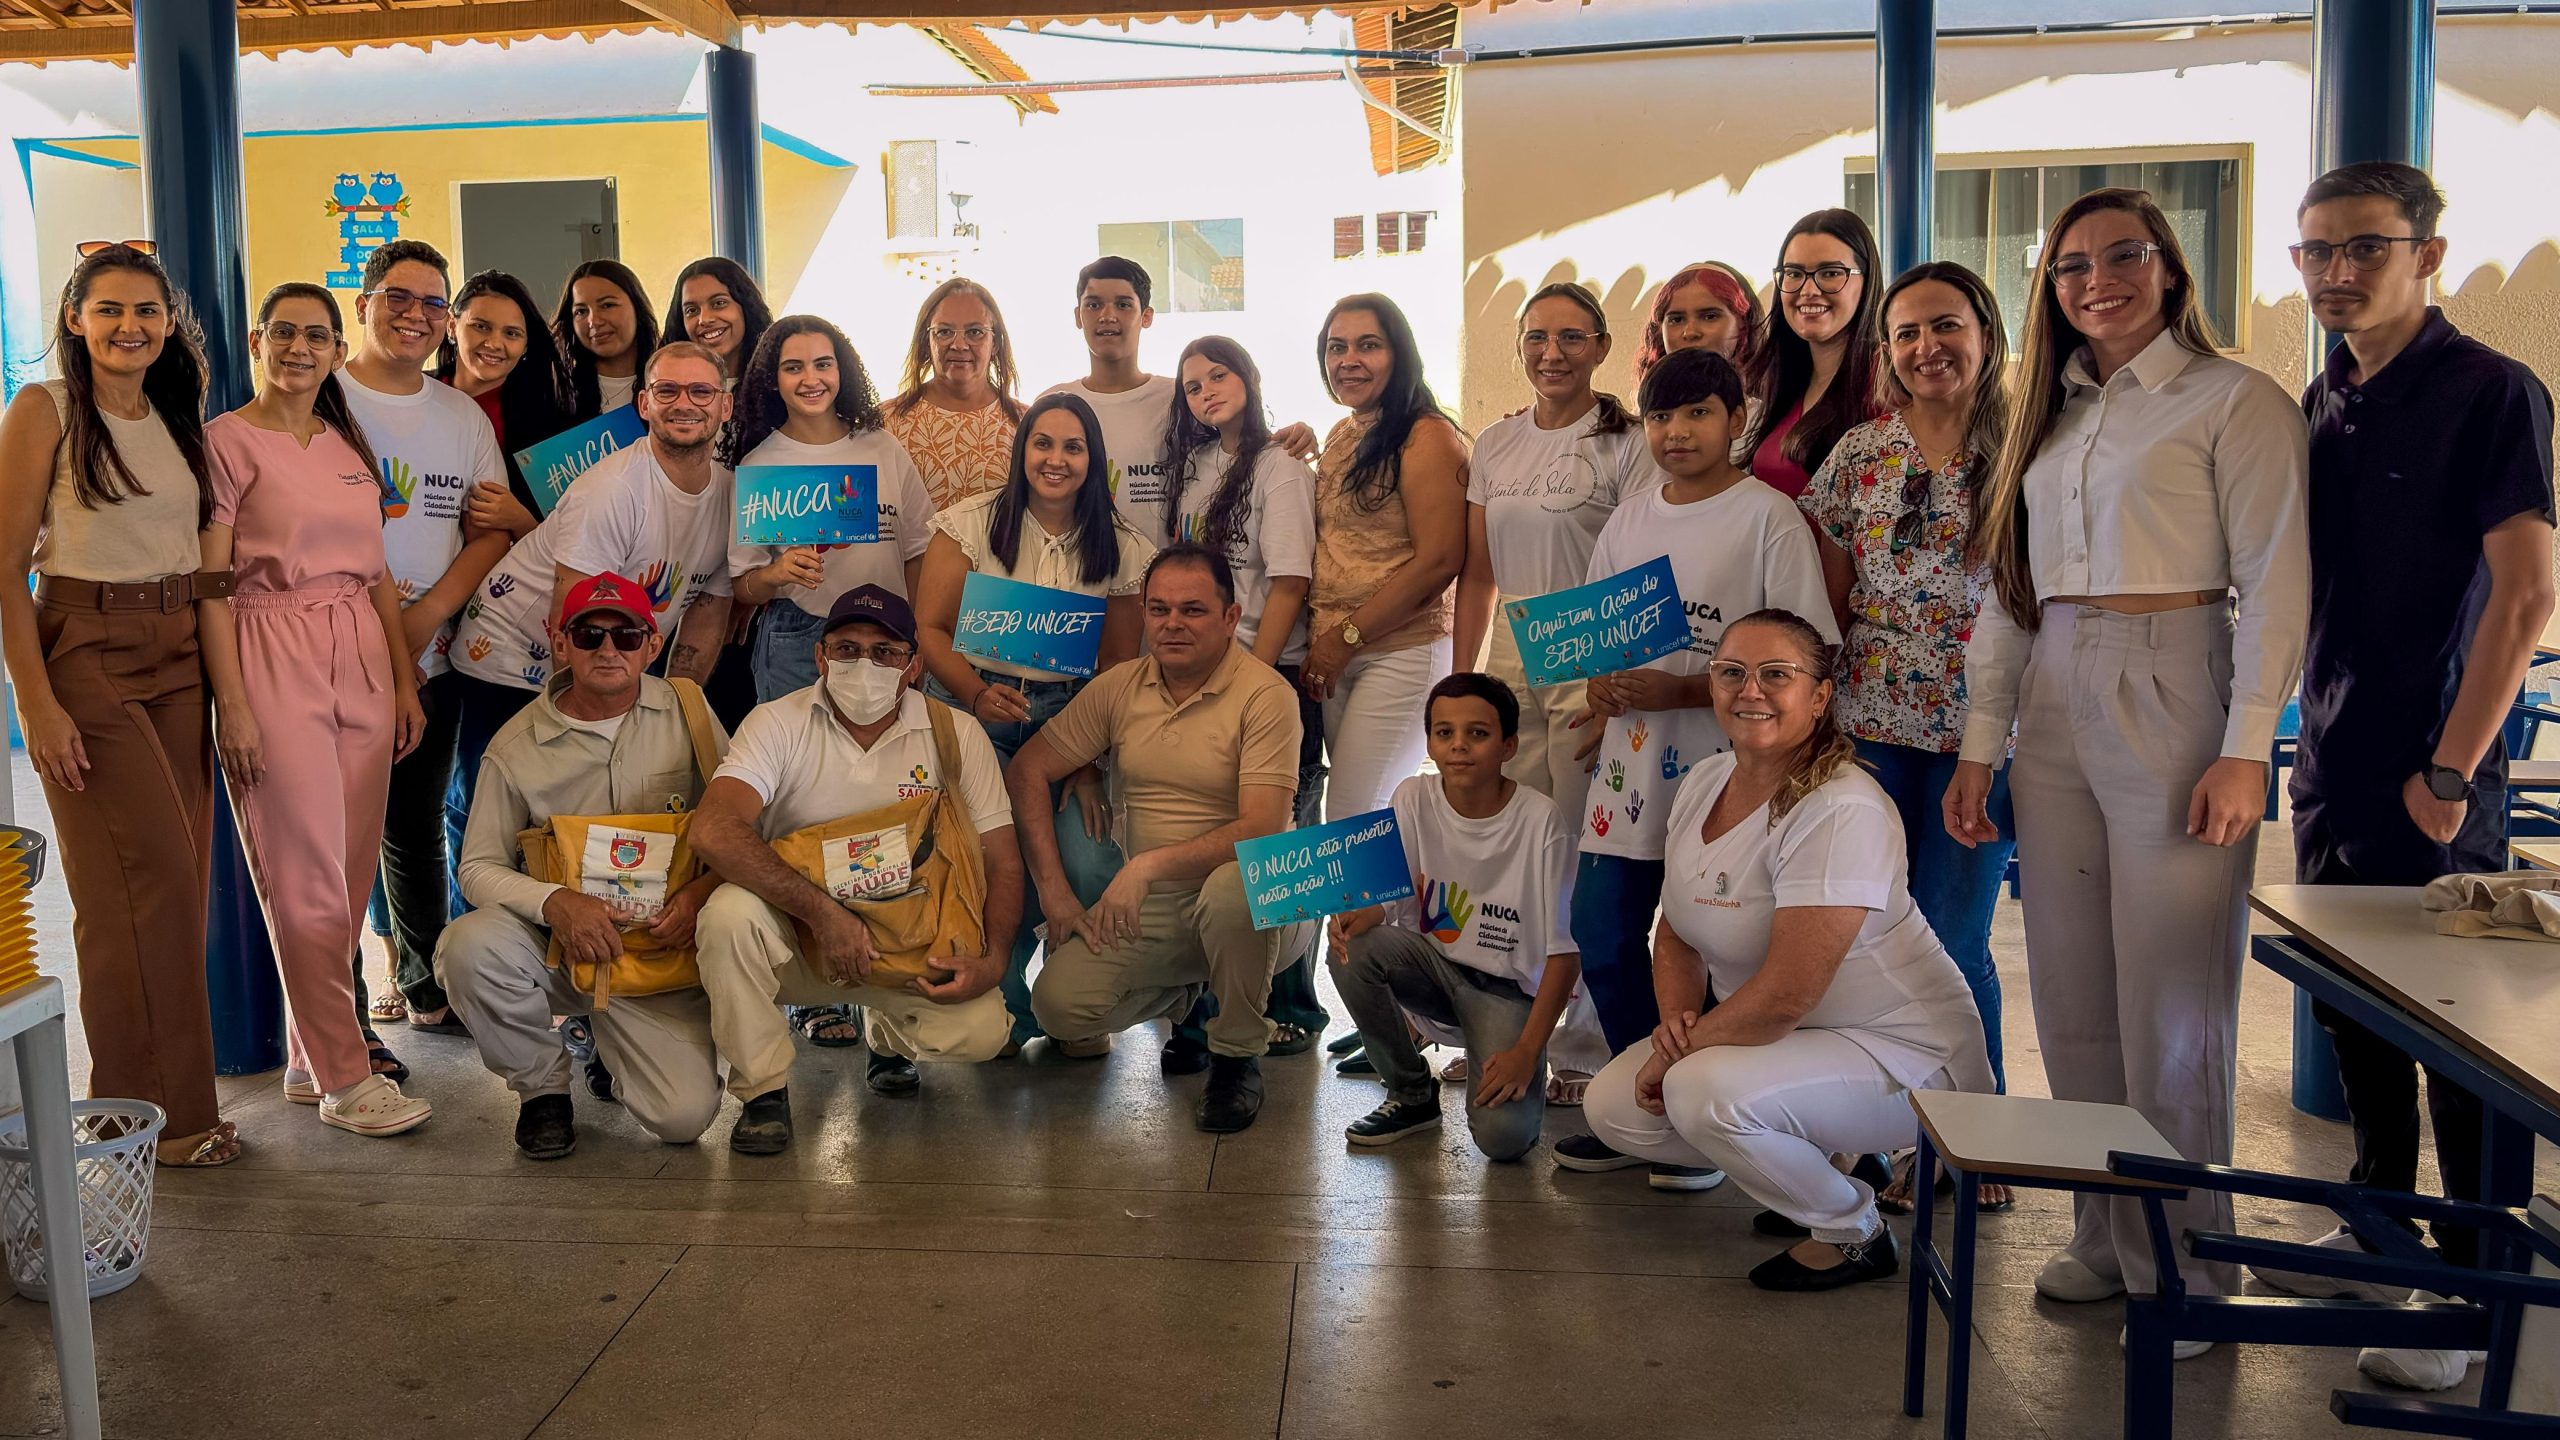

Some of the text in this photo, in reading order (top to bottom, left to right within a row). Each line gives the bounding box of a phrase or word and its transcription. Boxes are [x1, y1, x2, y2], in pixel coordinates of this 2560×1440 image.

[353, 225, 383, 234] SALA
[357, 251, 372, 259] DO
[1523, 474, 1541, 497] de
[1543, 470, 1576, 497] Sala
[424, 493, 446, 501] Núcleo
[877, 503, 899, 518] UCA
[846, 532, 867, 541] unicef
[1528, 574, 1659, 643] Aqui tem Ação do
[1682, 600, 1722, 623] UCA
[1026, 609, 1106, 635] UNICEF
[1599, 595, 1671, 649] UNICEF
[1657, 636, 1681, 655] unicef
[1060, 665, 1083, 674] unicef
[1247, 861, 1260, 884] O
[1265, 847, 1313, 877] NUCA
[1345, 817, 1394, 854] presente
[1258, 883, 1291, 905] nesta
[1295, 875, 1325, 896] ação
[1376, 887, 1401, 900] unicef
[1481, 902, 1520, 923] NUCA
